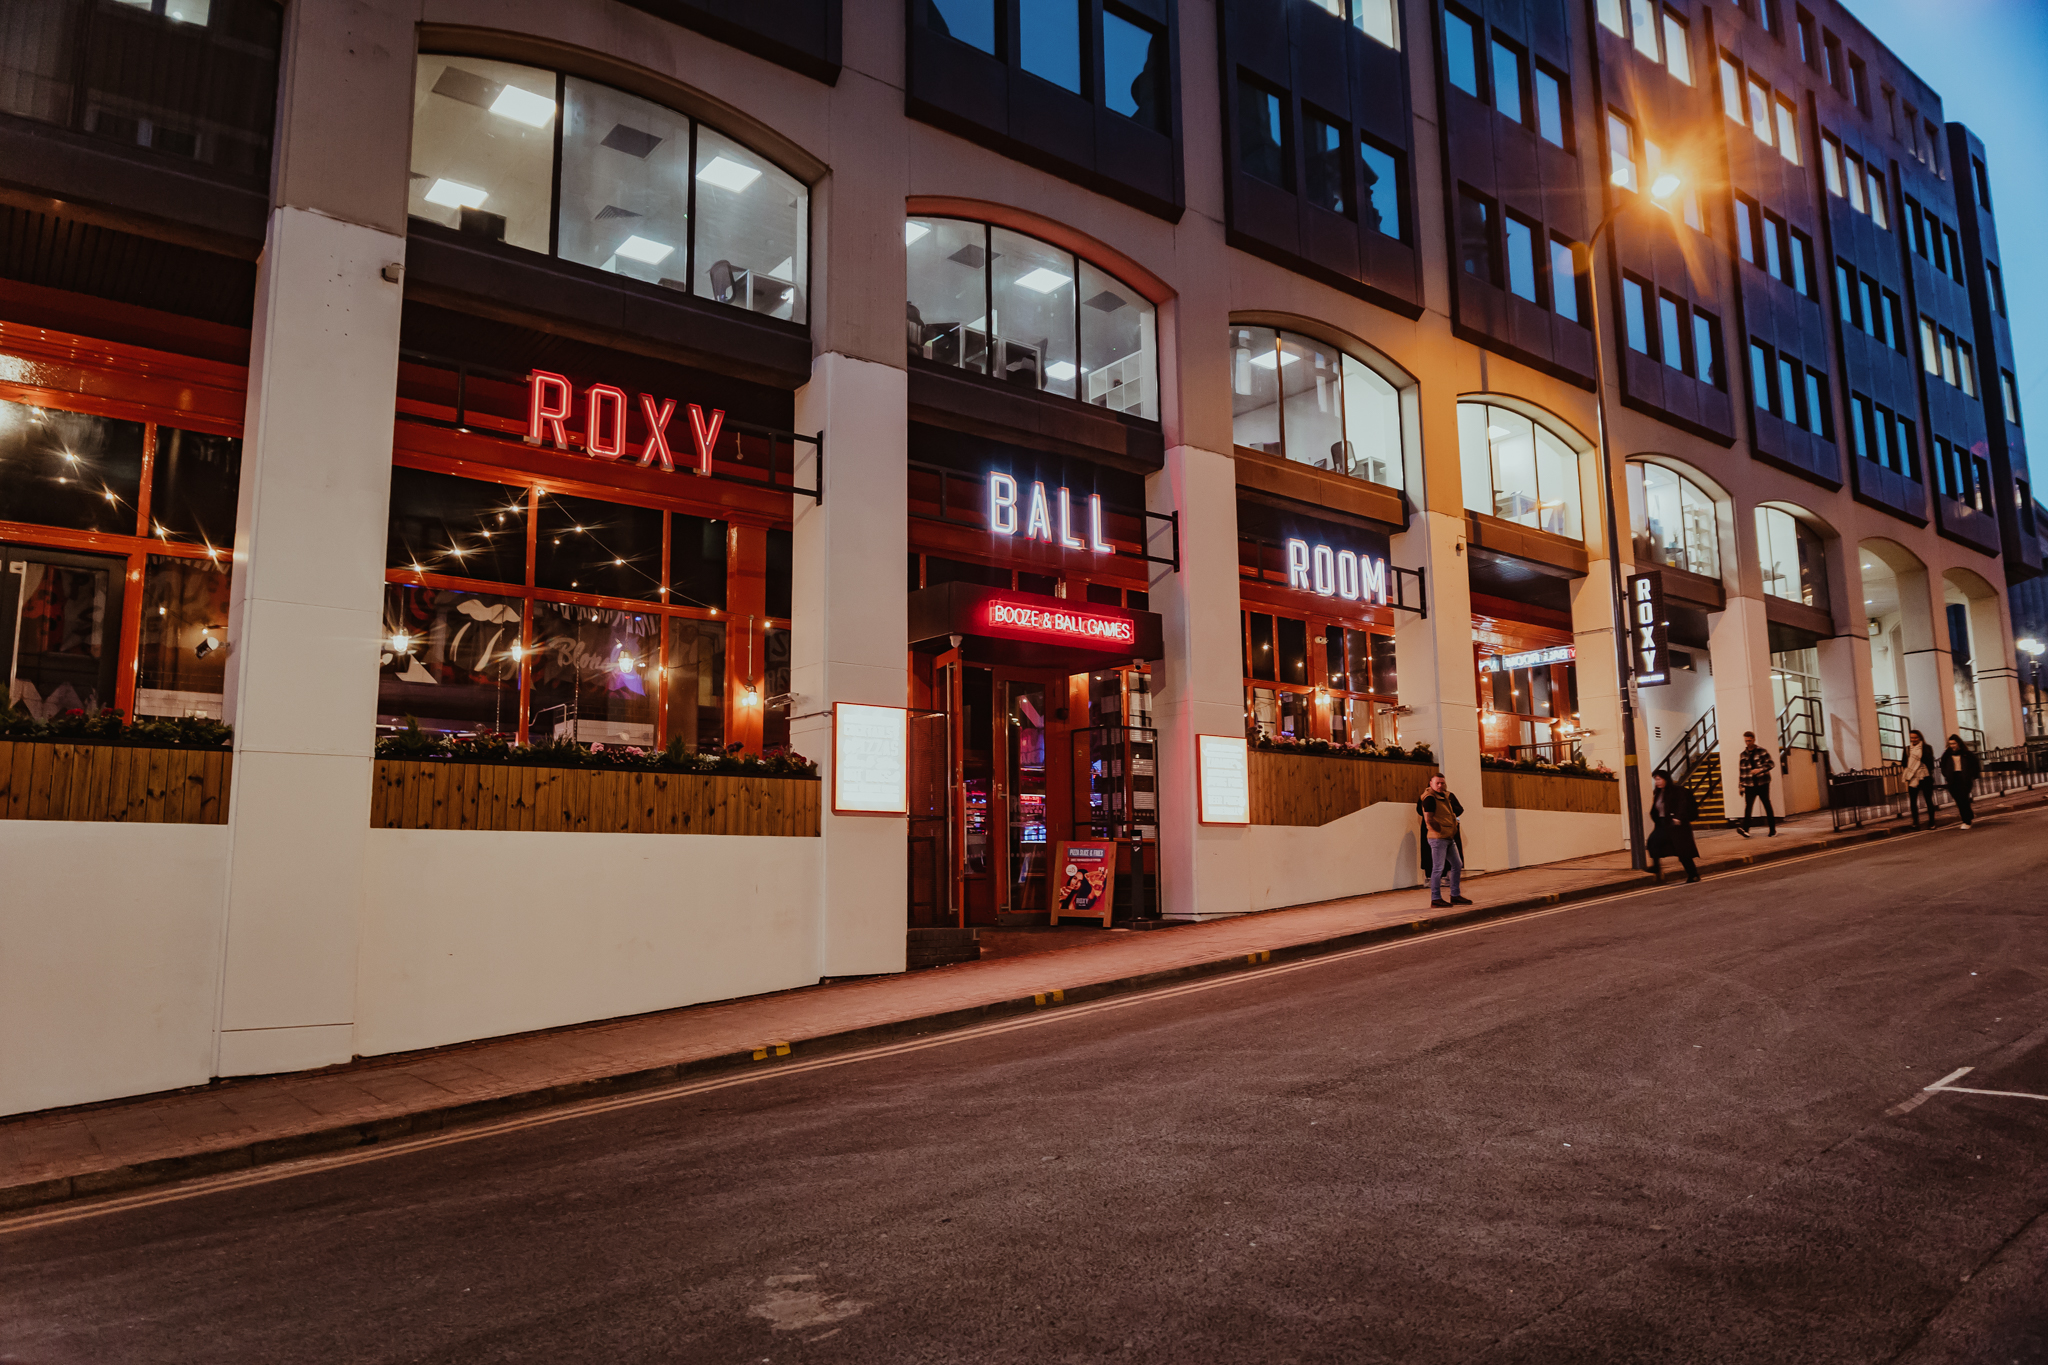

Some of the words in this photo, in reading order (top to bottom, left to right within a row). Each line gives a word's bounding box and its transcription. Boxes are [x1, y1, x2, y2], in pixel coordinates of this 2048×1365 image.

[528, 368, 725, 477] ROXY
[987, 471, 1116, 554] BALL
[1286, 538, 1387, 606] ROOM
[994, 605, 1040, 627] BOOZE
[1043, 612, 1052, 629] &
[1055, 613, 1085, 632] BALL
[1087, 618, 1131, 639] GAMES
[1636, 579, 1657, 672] ROXY
